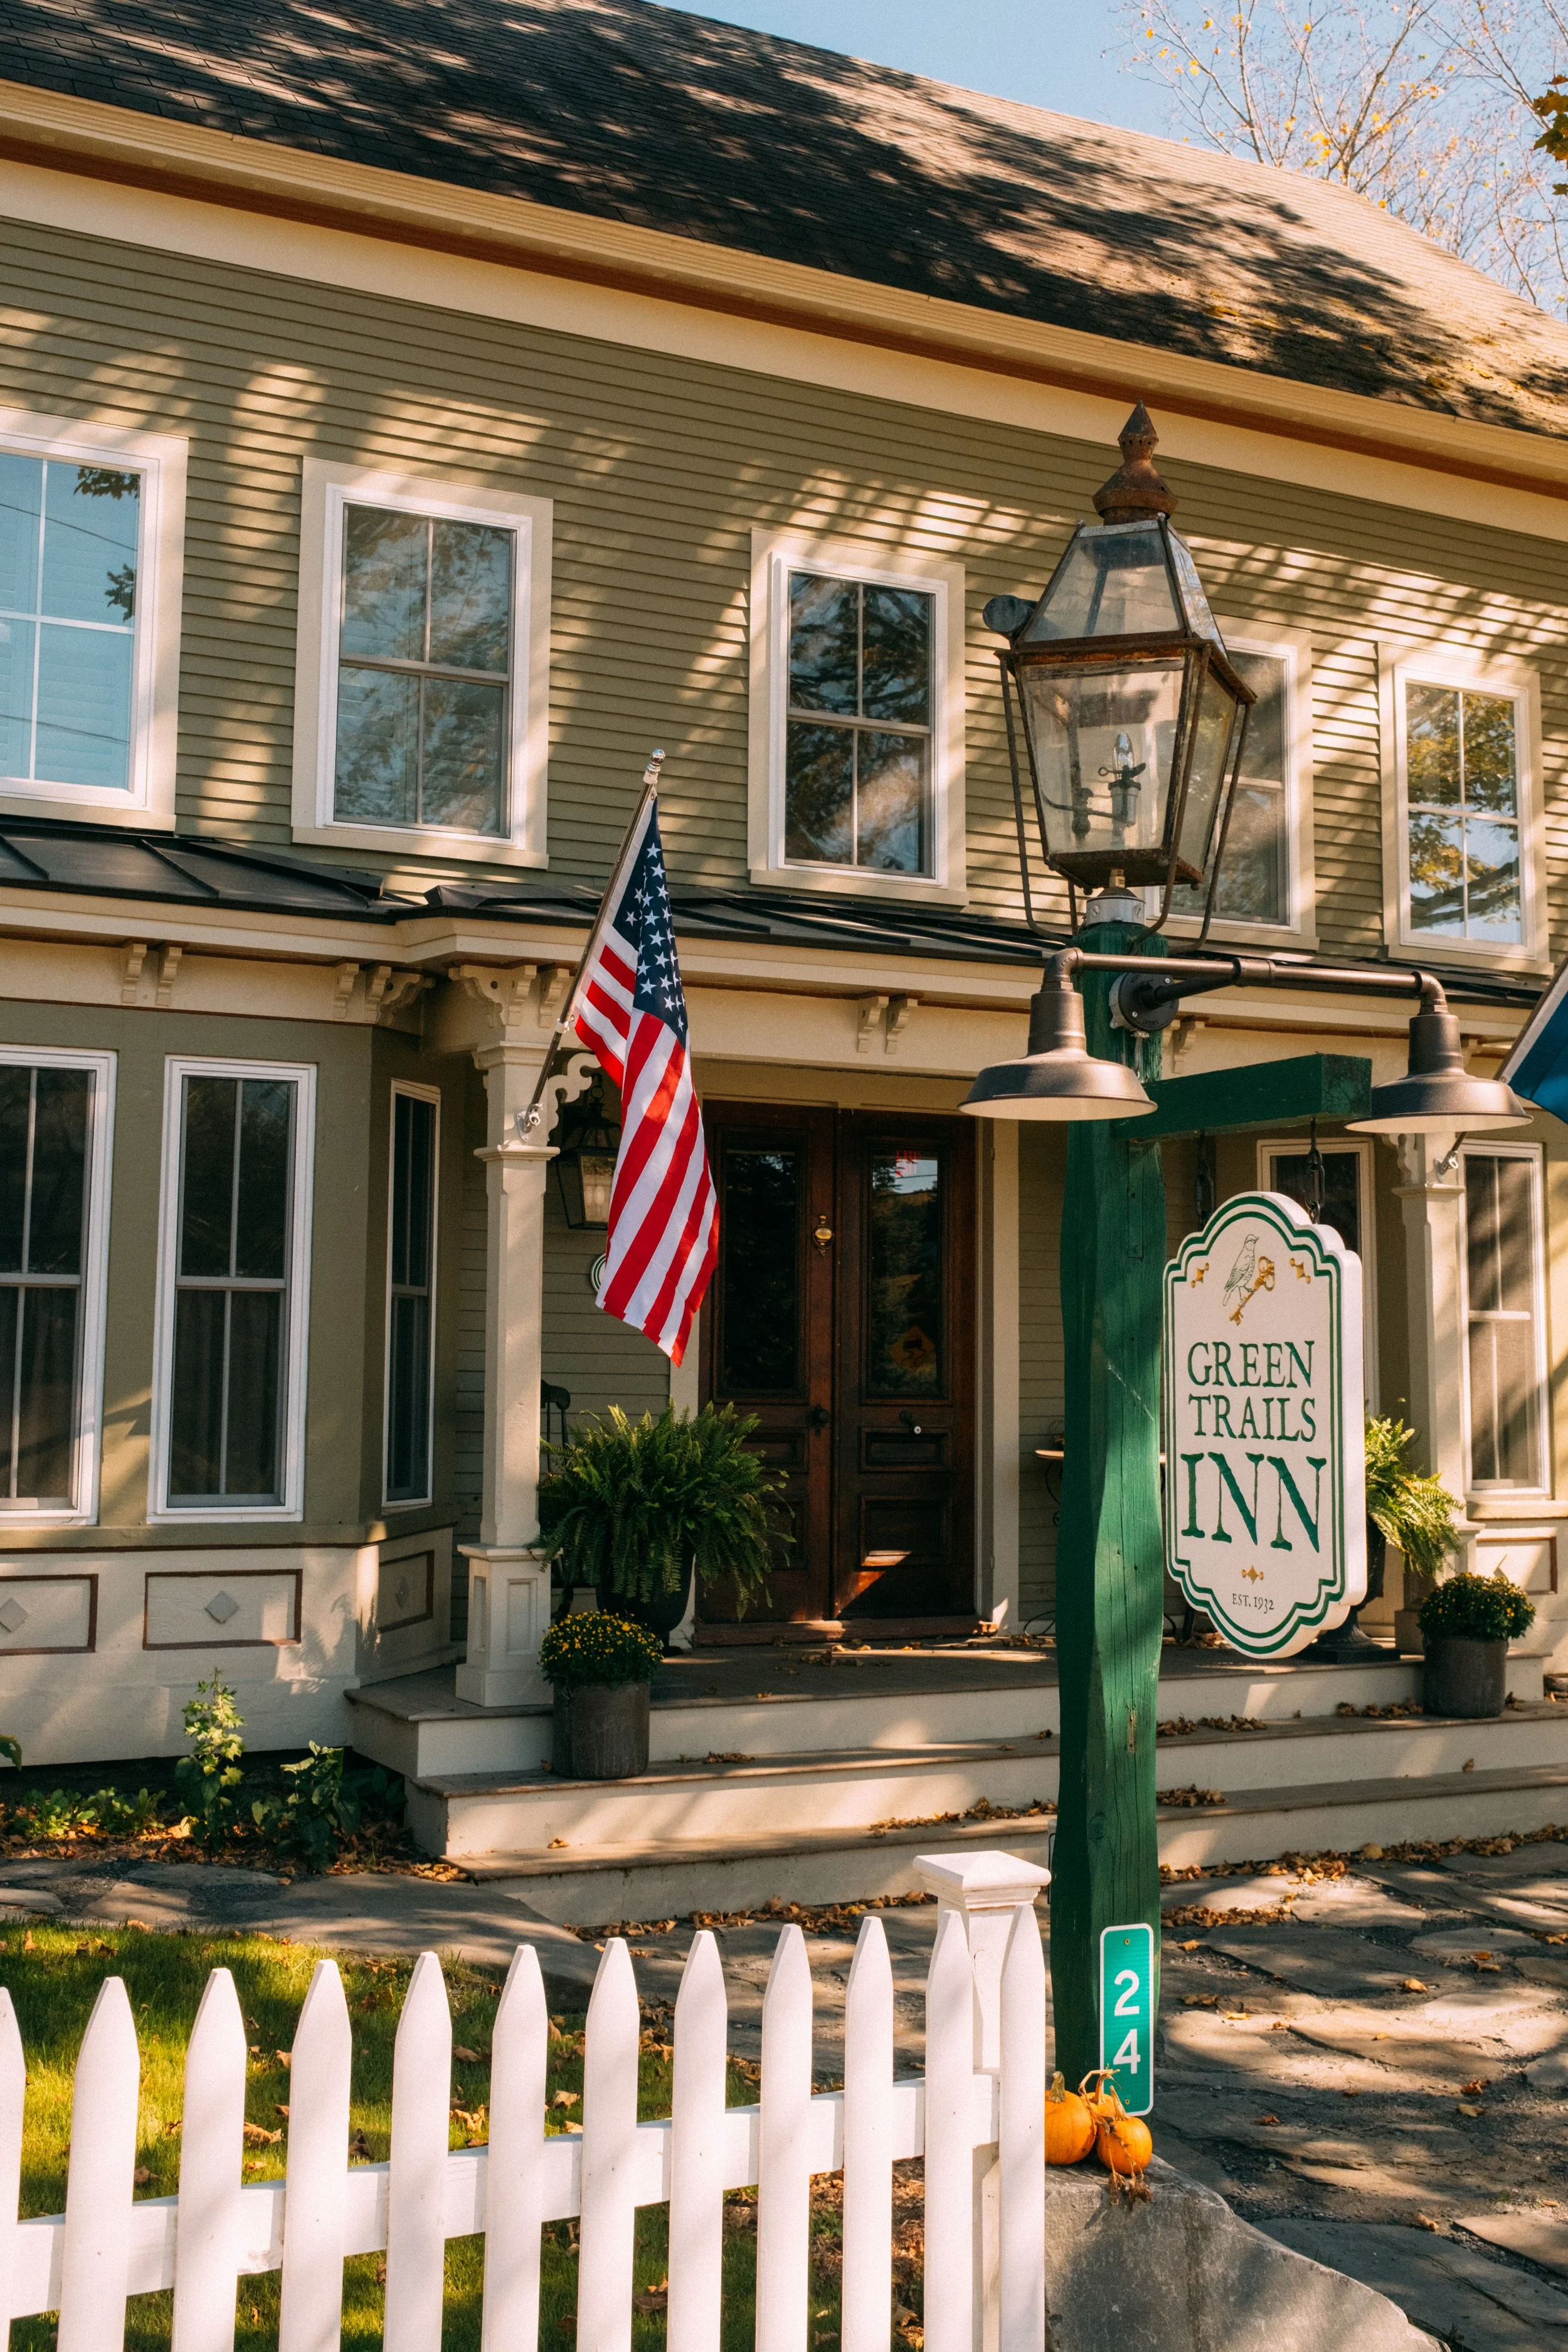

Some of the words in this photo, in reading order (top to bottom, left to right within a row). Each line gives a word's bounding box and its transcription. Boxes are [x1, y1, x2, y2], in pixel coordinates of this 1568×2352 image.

[1187, 1340, 1315, 1389] GREEN
[1188, 1393, 1316, 1443] TRAILS
[1180, 1451, 1327, 1554] INN
[1232, 1593, 1251, 1608] EST.
[1254, 1596, 1274, 1614] 1932
